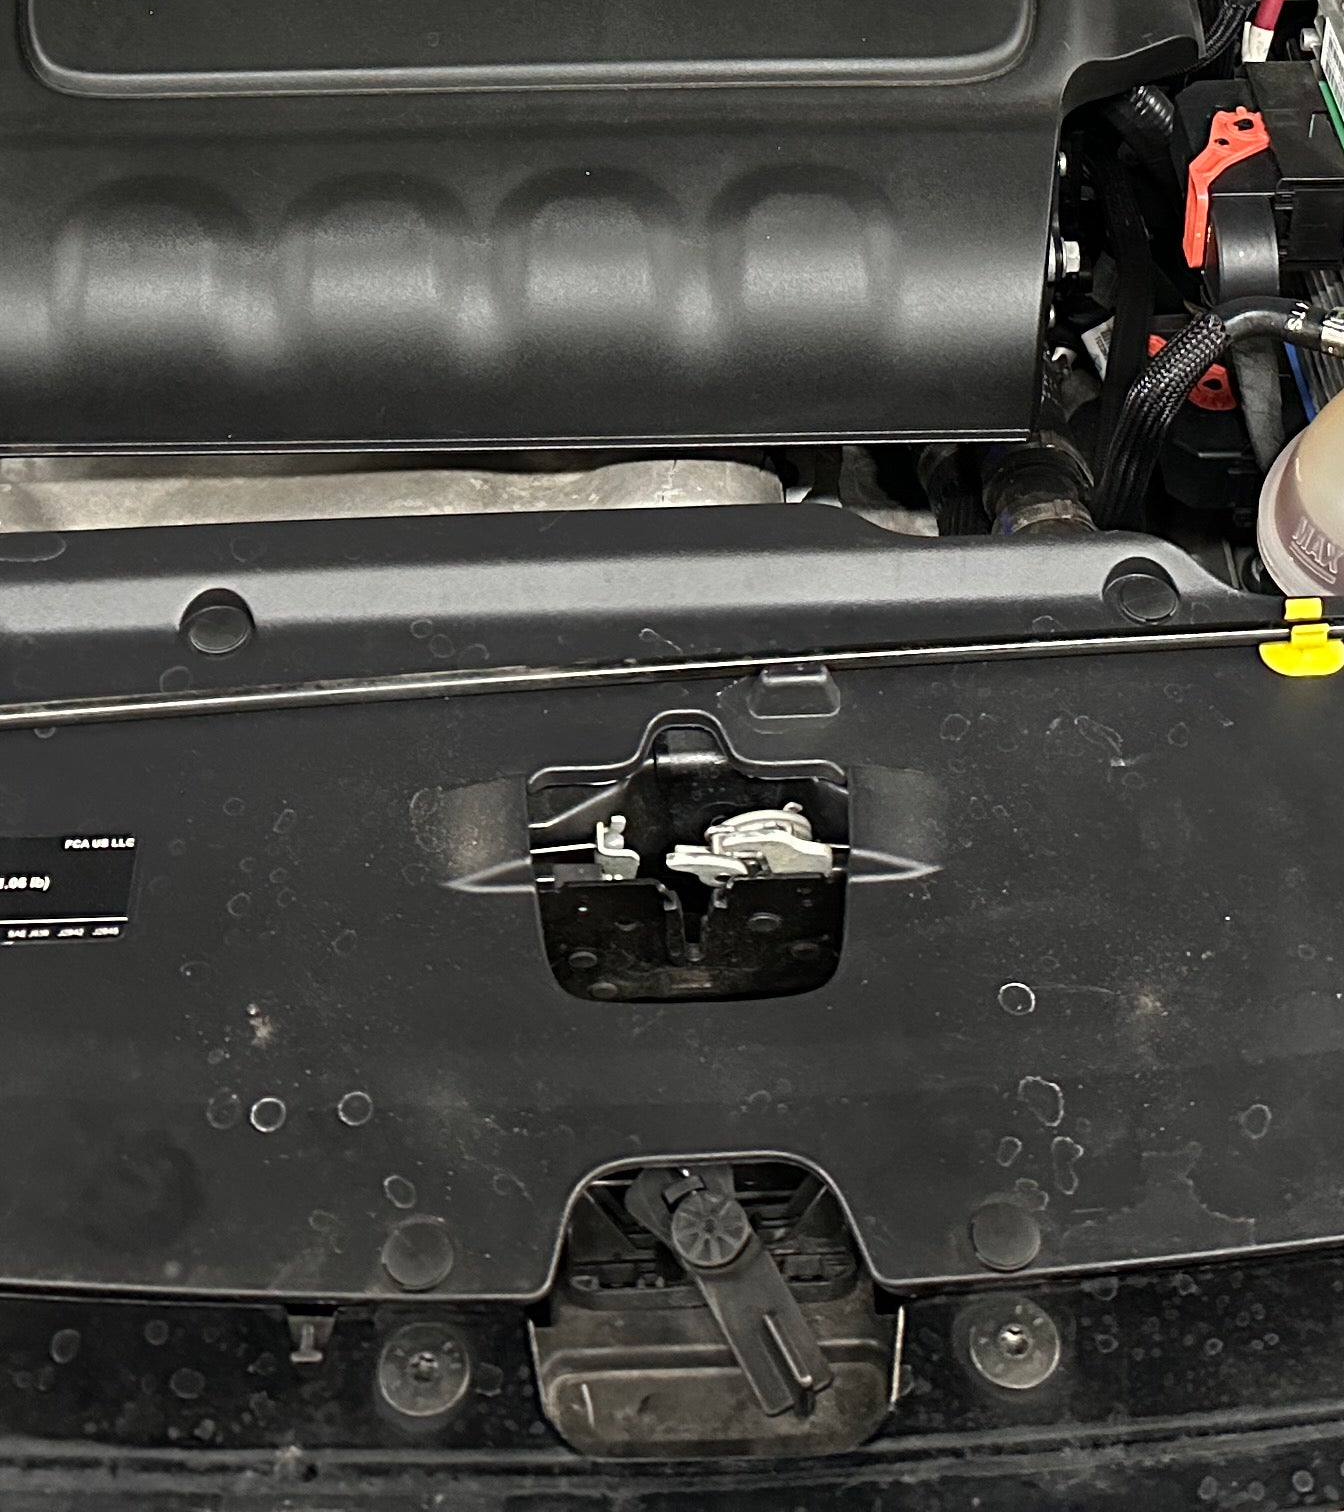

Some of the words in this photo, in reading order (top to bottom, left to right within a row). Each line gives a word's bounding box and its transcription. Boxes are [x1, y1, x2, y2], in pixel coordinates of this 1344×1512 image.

[64, 838, 90, 850] FCA
[109, 837, 136, 849] LLC
[28, 875, 51, 892] lb)
